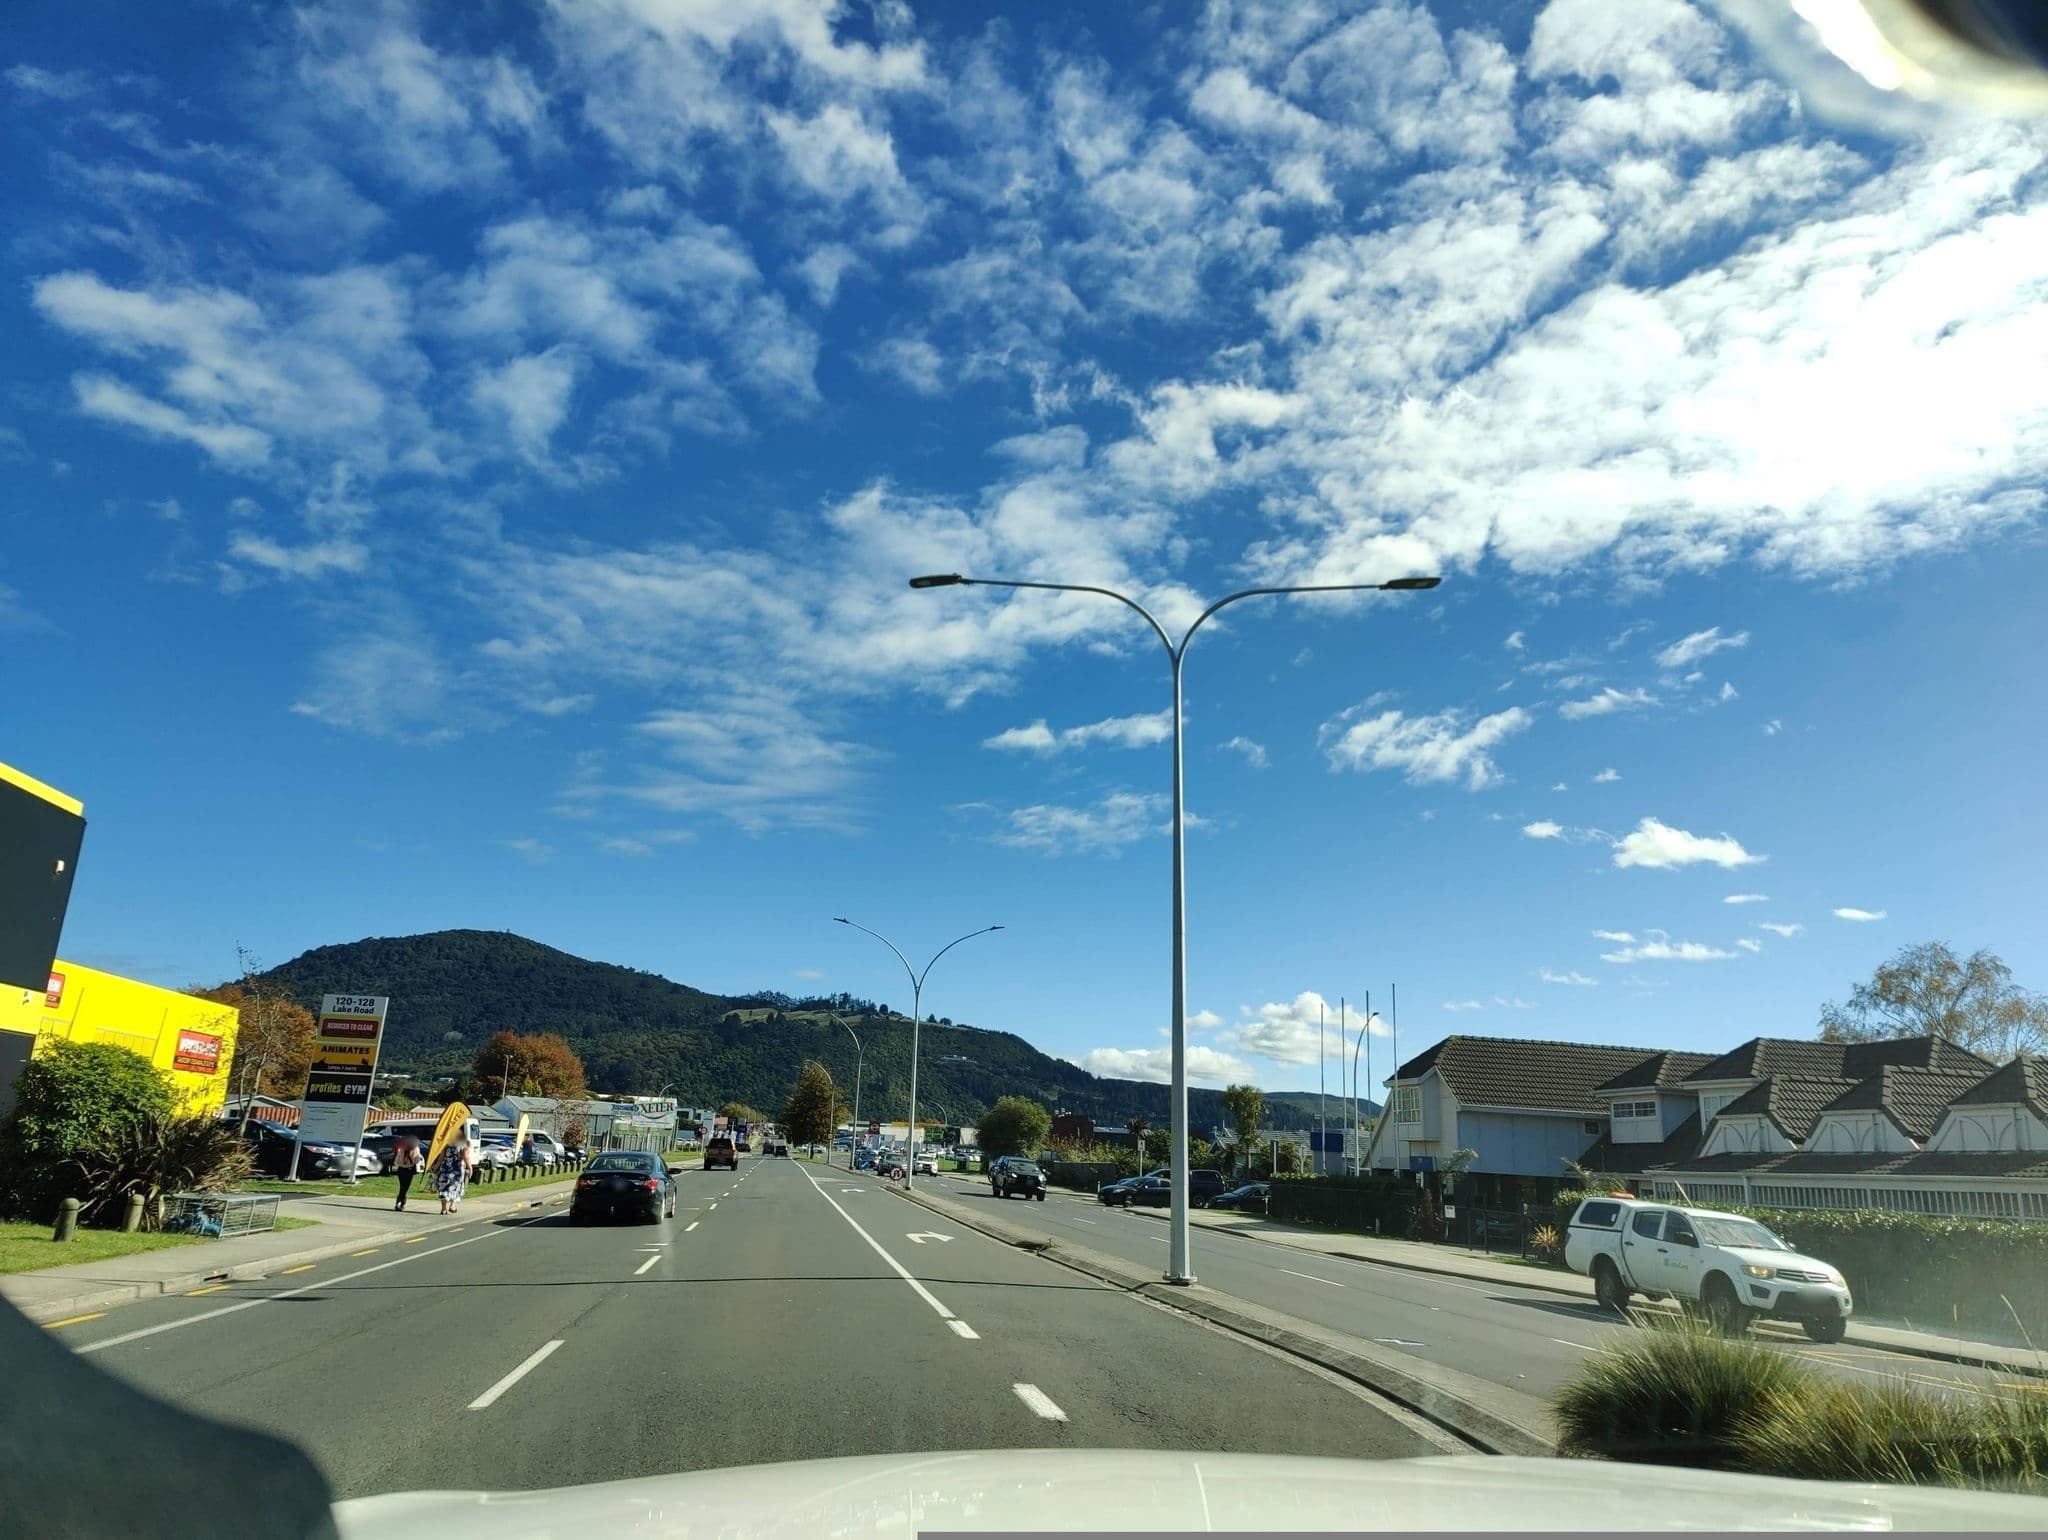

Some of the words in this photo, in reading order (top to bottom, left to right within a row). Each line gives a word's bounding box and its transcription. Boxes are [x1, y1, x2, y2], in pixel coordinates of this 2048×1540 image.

[353, 1006, 375, 1014] Road
[327, 1022, 350, 1030] REDUCED
[321, 1046, 370, 1054] ANIMATES
[311, 1082, 342, 1094] profiles
[344, 1085, 367, 1095] GYM
